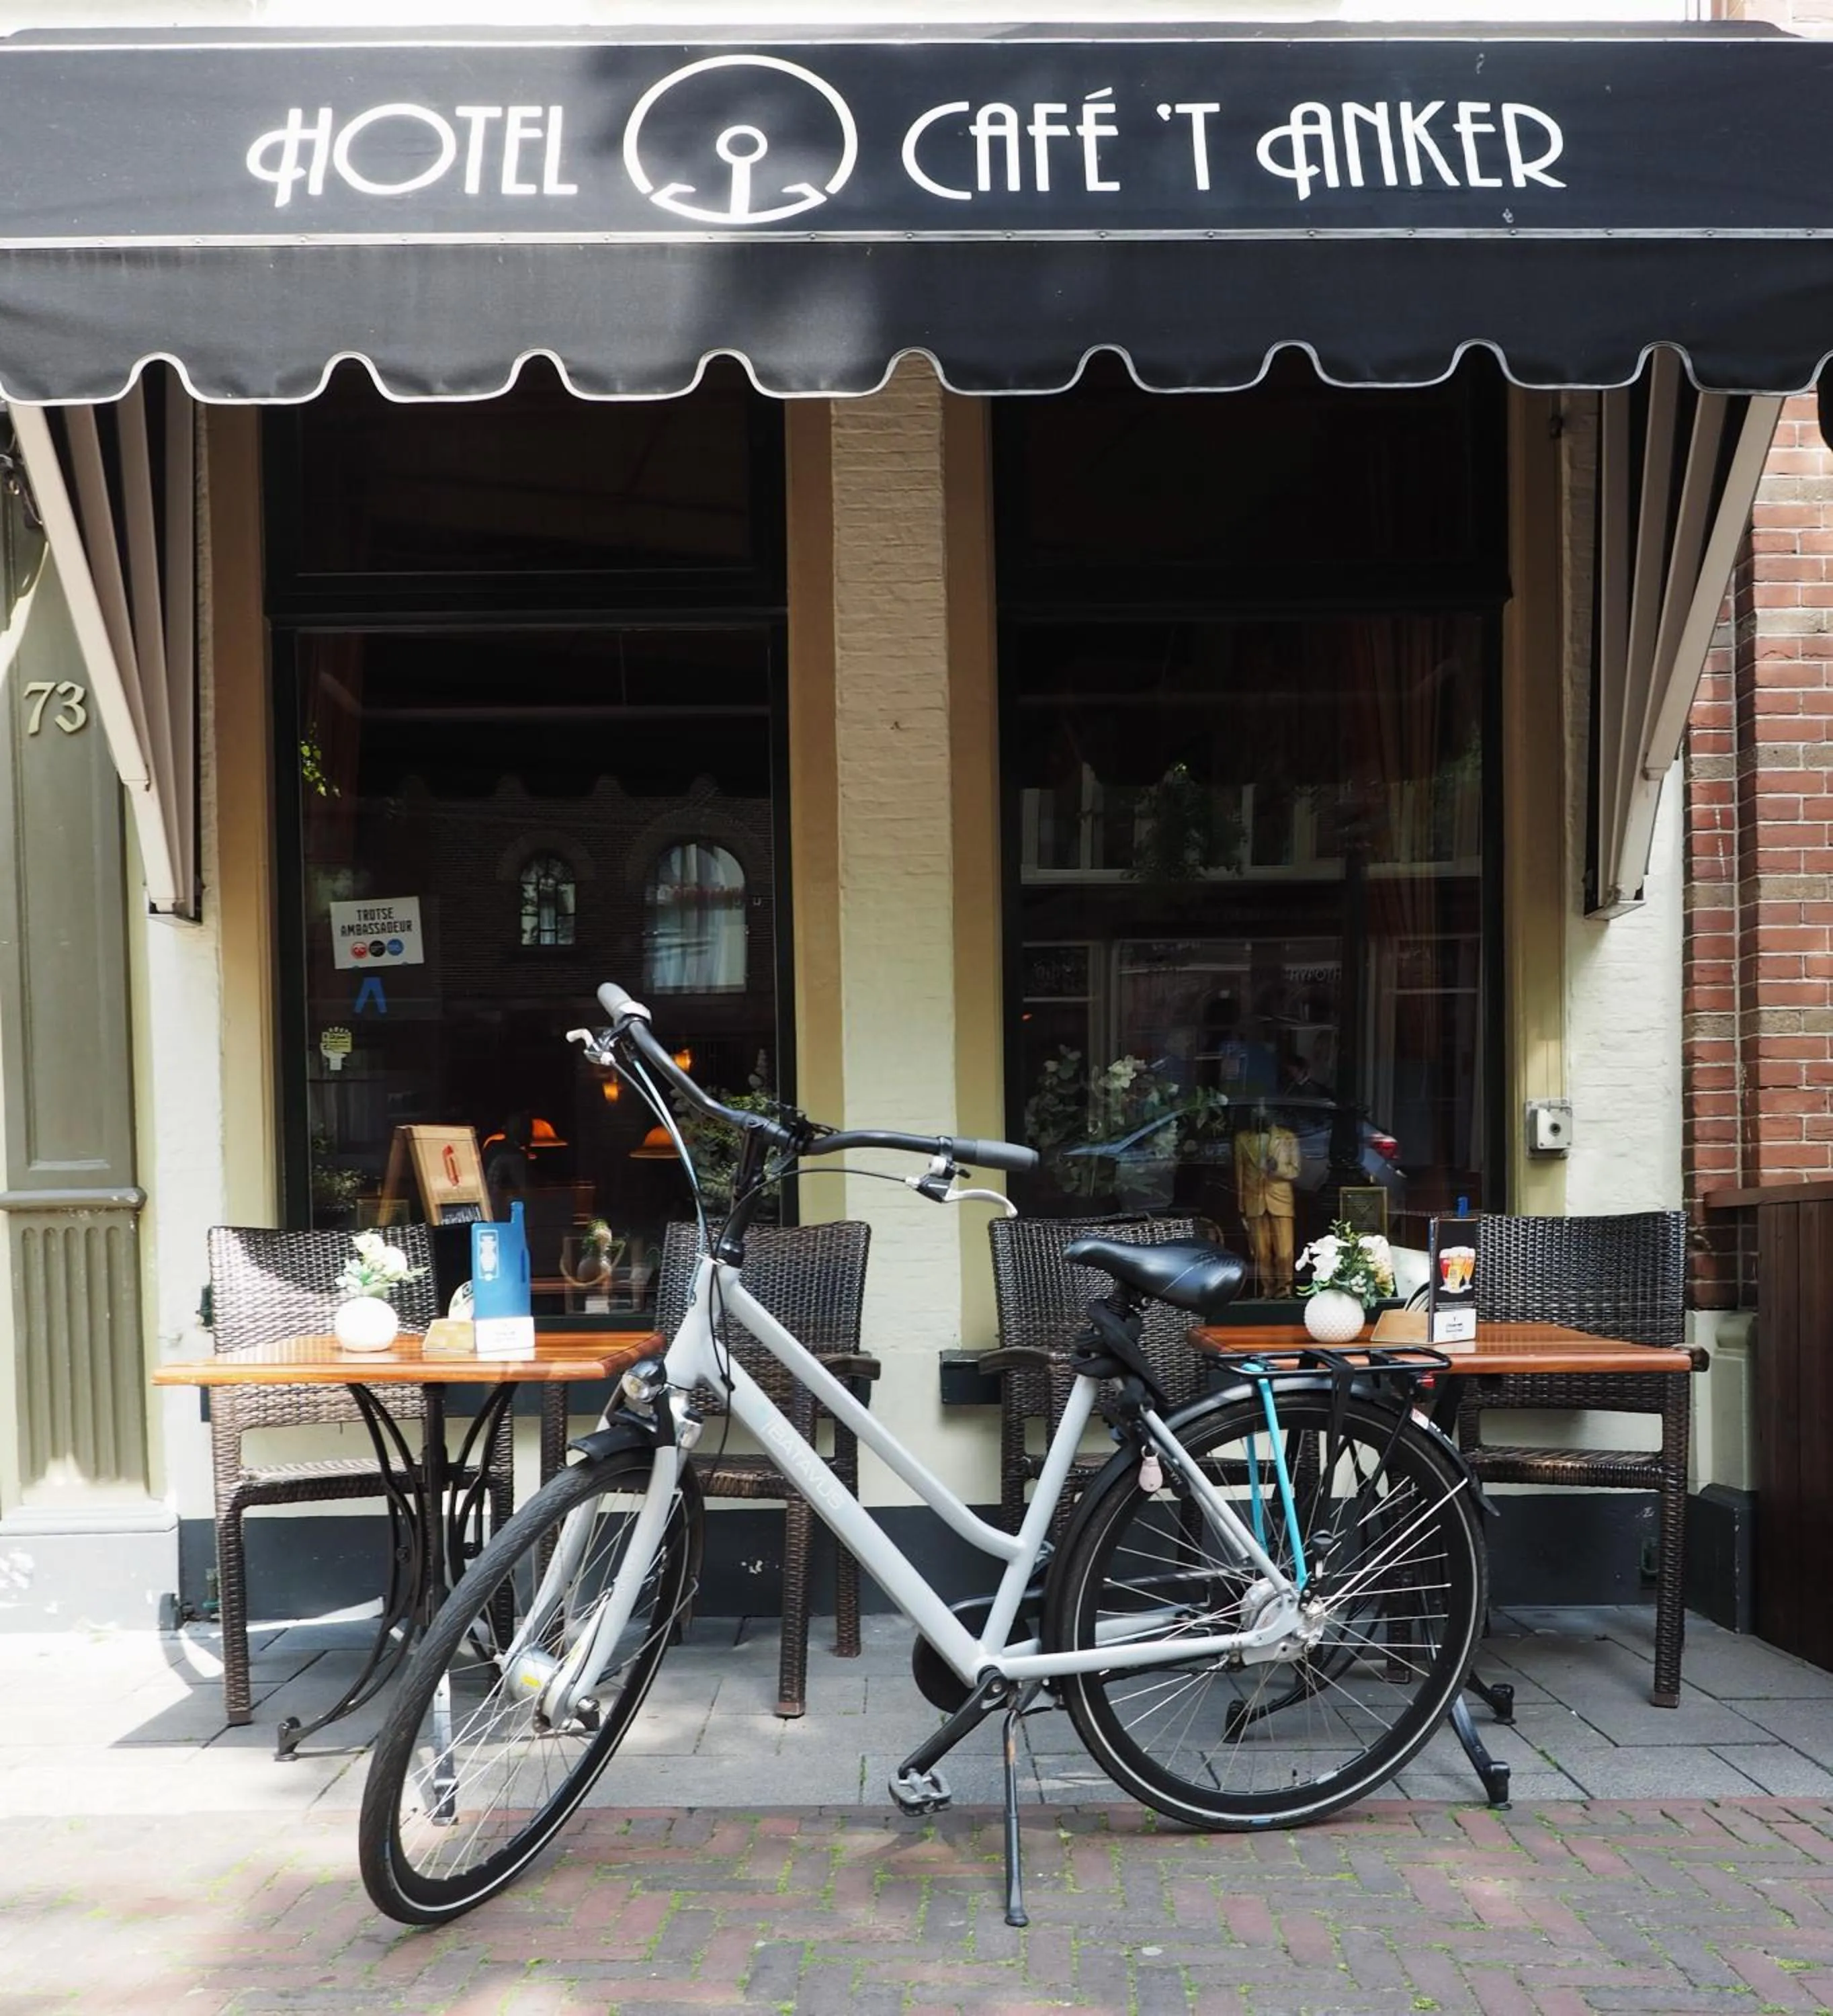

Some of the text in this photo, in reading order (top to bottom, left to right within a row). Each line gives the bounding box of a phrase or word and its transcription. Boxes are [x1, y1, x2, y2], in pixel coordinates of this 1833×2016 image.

[246, 102, 578, 207] HOTEL
[901, 87, 1121, 200] CAFÉ
[1256, 100, 1567, 201] ANKER
[24, 681, 87, 734] 73
[341, 920, 413, 937] AMBASSADEUR
[356, 907, 394, 921] TROTSE
[767, 1421, 844, 1510] BATAVUS
